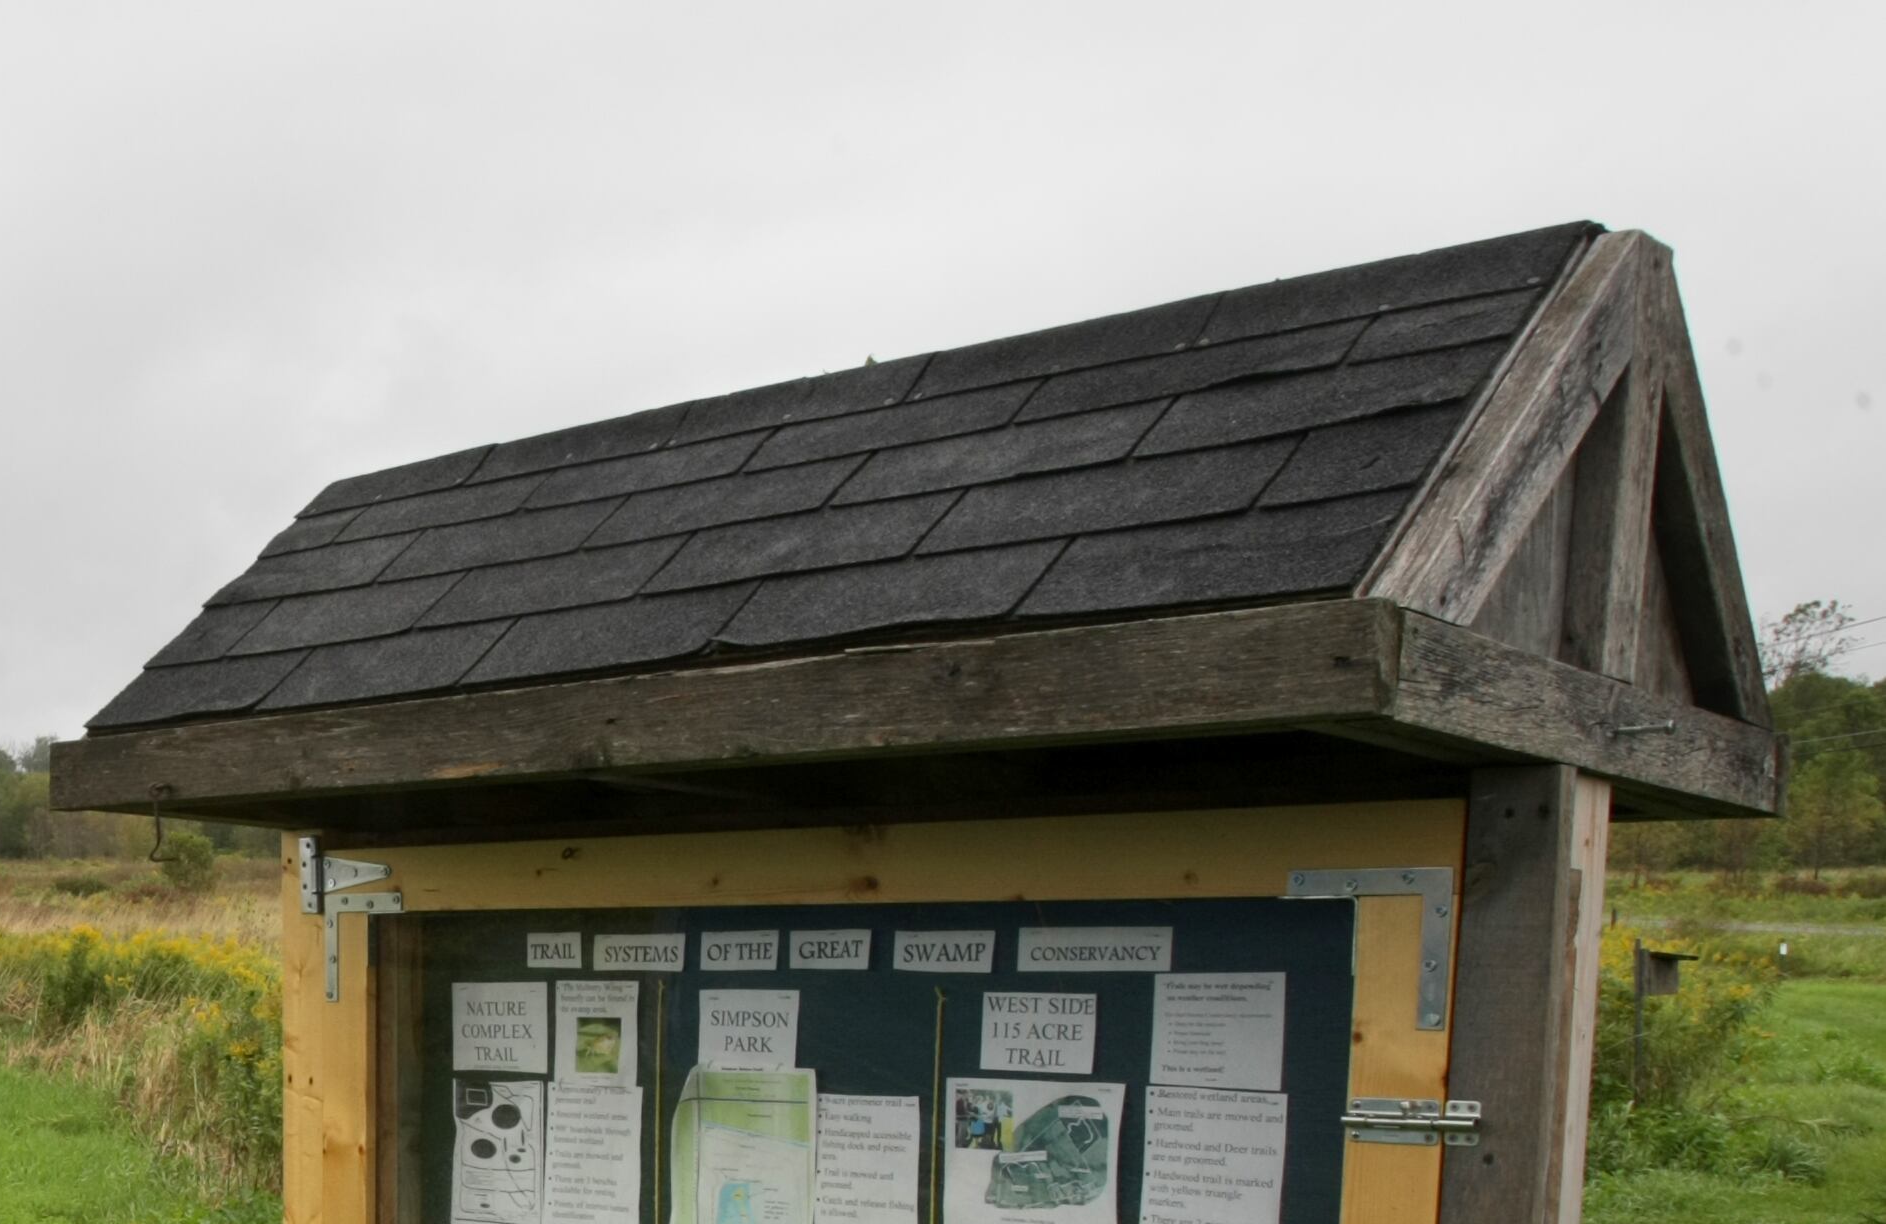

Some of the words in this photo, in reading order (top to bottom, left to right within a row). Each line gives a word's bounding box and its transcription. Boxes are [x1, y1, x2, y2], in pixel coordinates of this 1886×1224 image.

[530, 943, 576, 960] TRAIL
[604, 944, 679, 963] SYSTEMS
[707, 943, 732, 961] OF
[735, 942, 773, 961] THE
[798, 939, 864, 960] GREAT
[903, 942, 986, 962] SWAMP
[1030, 945, 1162, 962] CONSERVANCY
[466, 1001, 527, 1017] NATURE
[987, 996, 1042, 1014] WEST
[1047, 997, 1096, 1015] SIDE
[710, 1009, 790, 1028] SIMPSON
[461, 1023, 533, 1040] COMPLEX
[992, 1022, 1021, 1040] 115
[1026, 1023, 1083, 1041] ACRE
[724, 1035, 774, 1053] PARK
[474, 1046, 519, 1062] TRAIL
[1005, 1047, 1065, 1066] TRAIL
